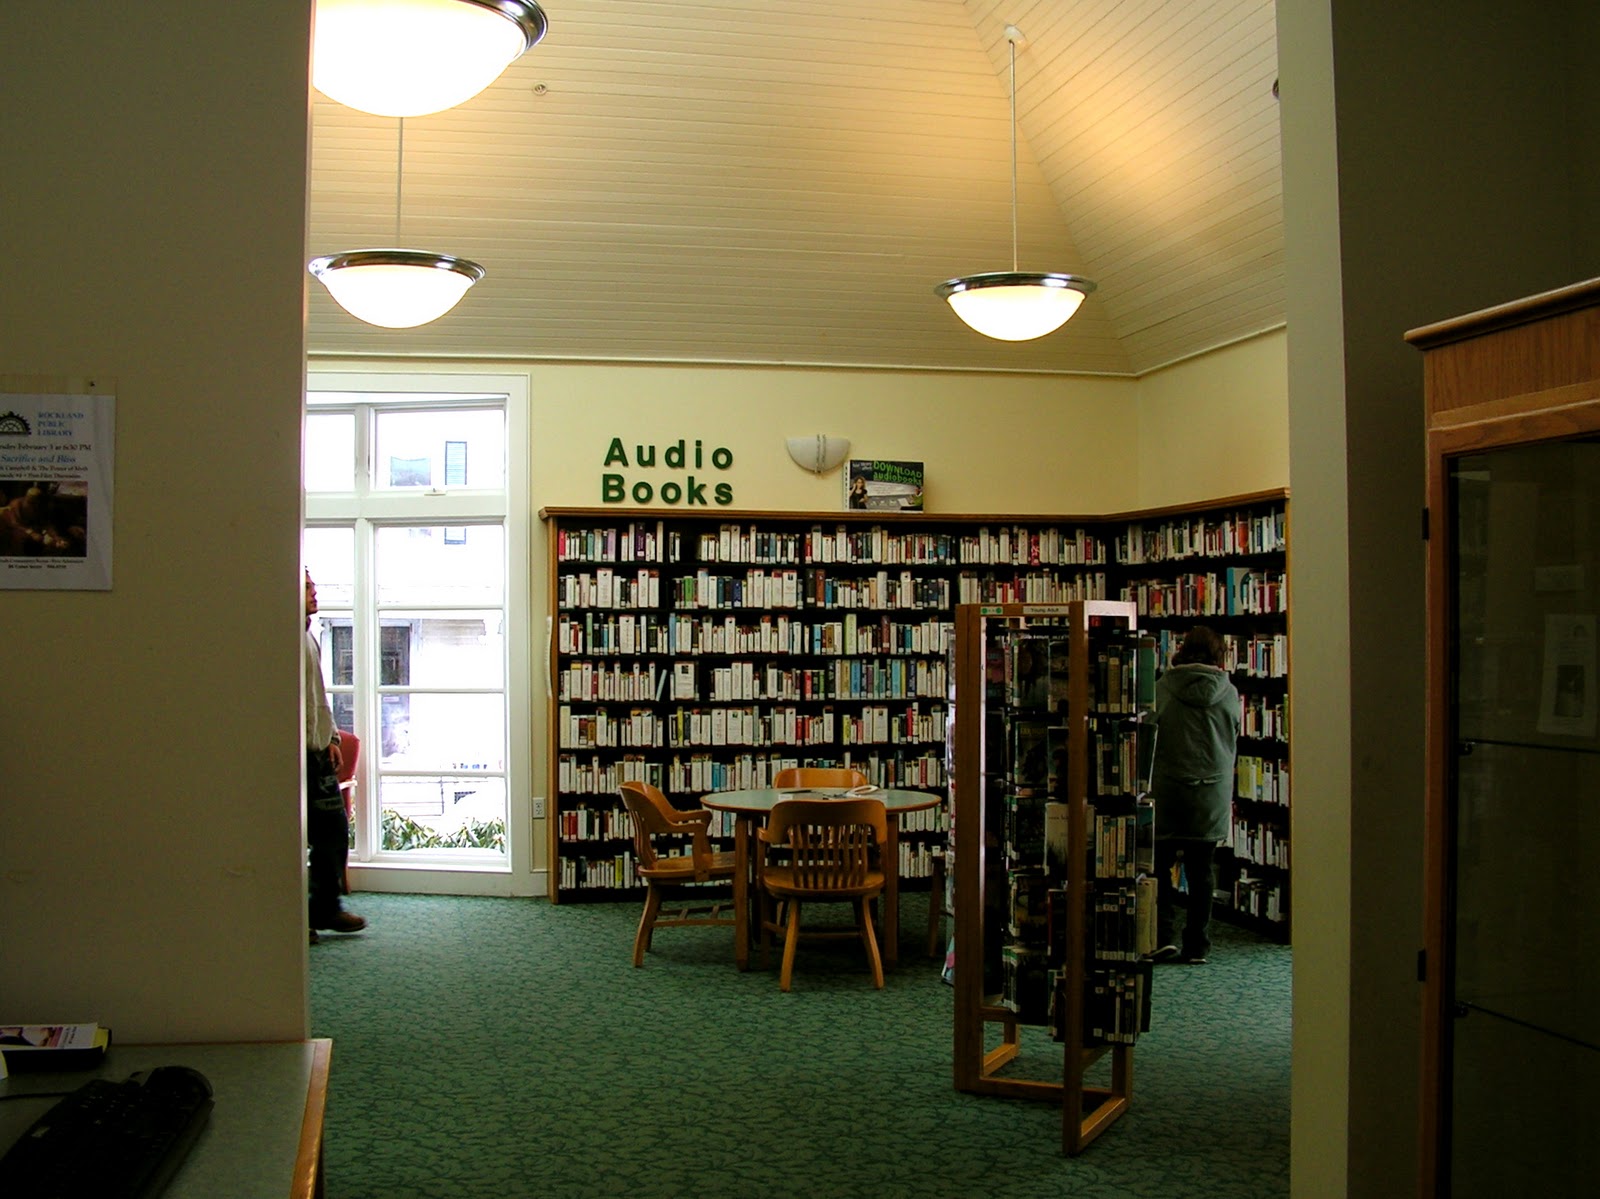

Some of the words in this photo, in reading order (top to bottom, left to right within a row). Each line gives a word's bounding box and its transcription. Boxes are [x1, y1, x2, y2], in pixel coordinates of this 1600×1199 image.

[2, 454, 34, 463] Sacrifice
[38, 454, 55, 463] and
[604, 437, 733, 469] Audio
[873, 460, 922, 478] DOWNLOAD
[873, 471, 922, 486] audiobooks
[602, 473, 733, 505] Books
